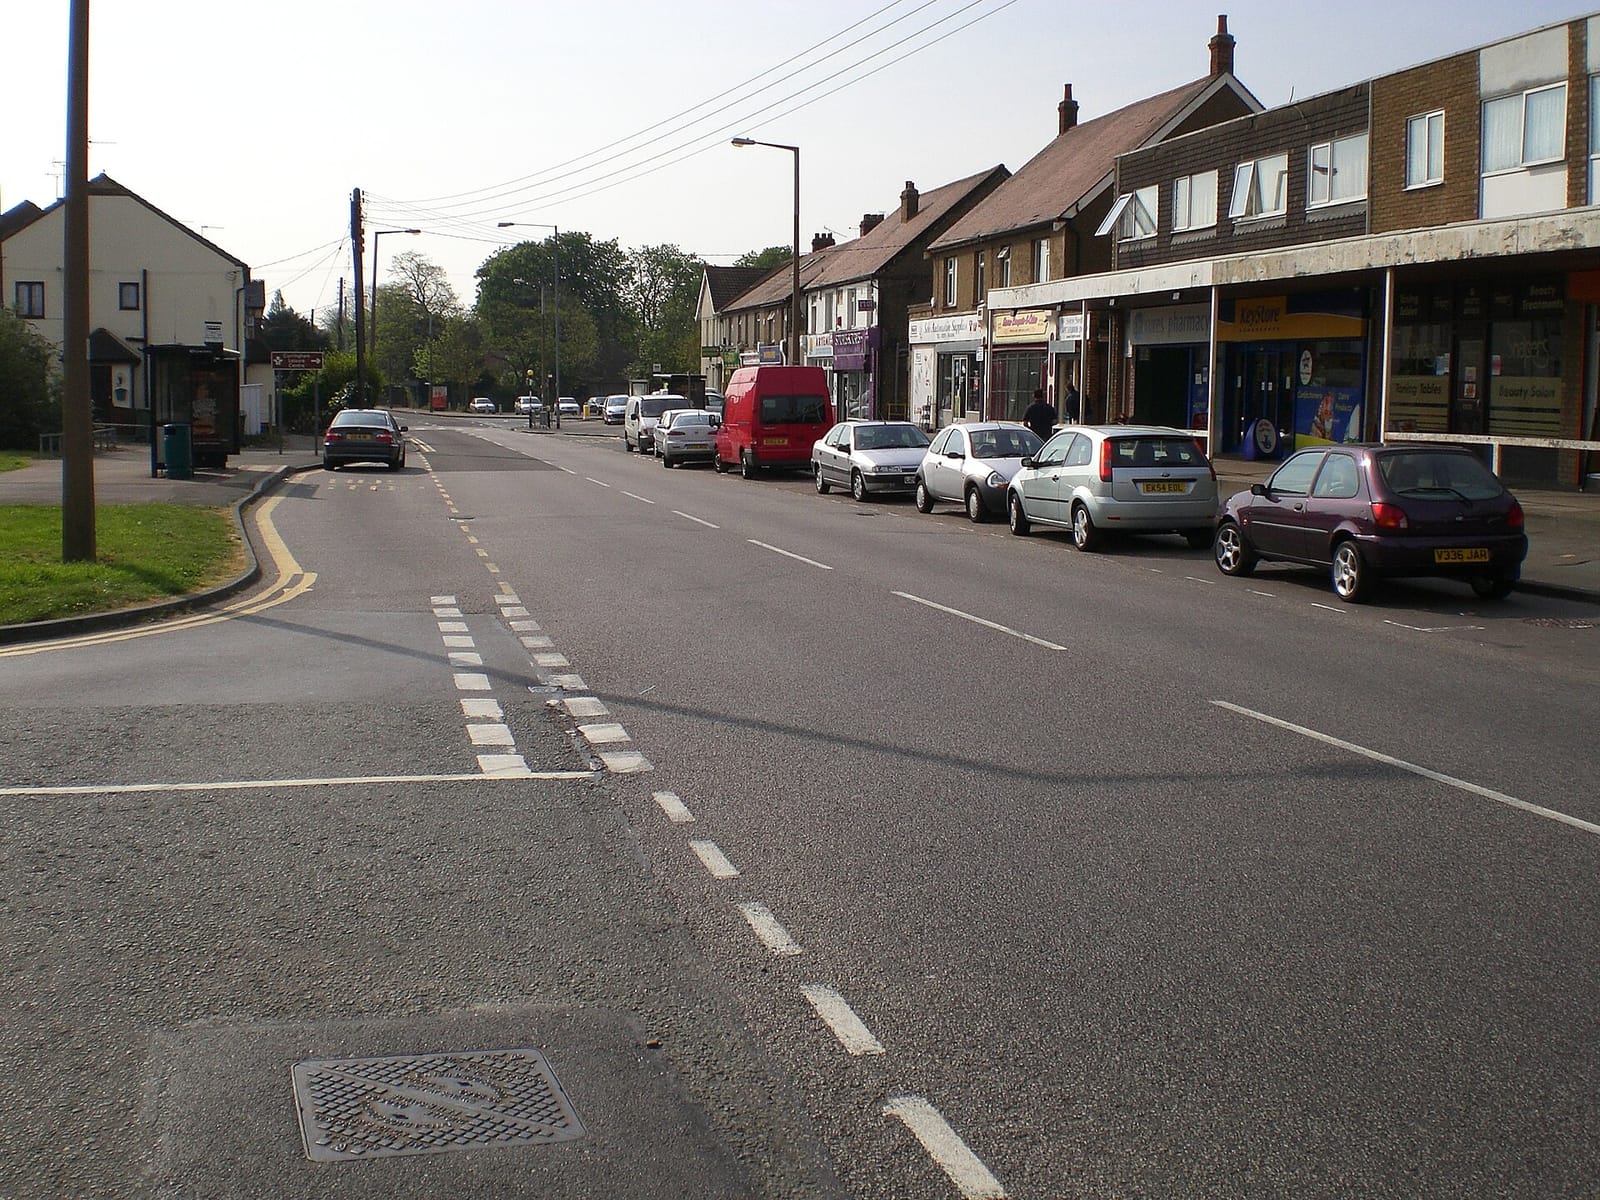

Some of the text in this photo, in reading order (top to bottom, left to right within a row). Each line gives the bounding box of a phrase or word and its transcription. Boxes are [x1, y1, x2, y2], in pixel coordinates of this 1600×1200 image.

[1167, 311, 1209, 336] pharmacy
[1240, 304, 1280, 326] KeyStore
[1499, 384, 1555, 400] Beauty Salon
[1437, 549, 1488, 561] V336 JAR
